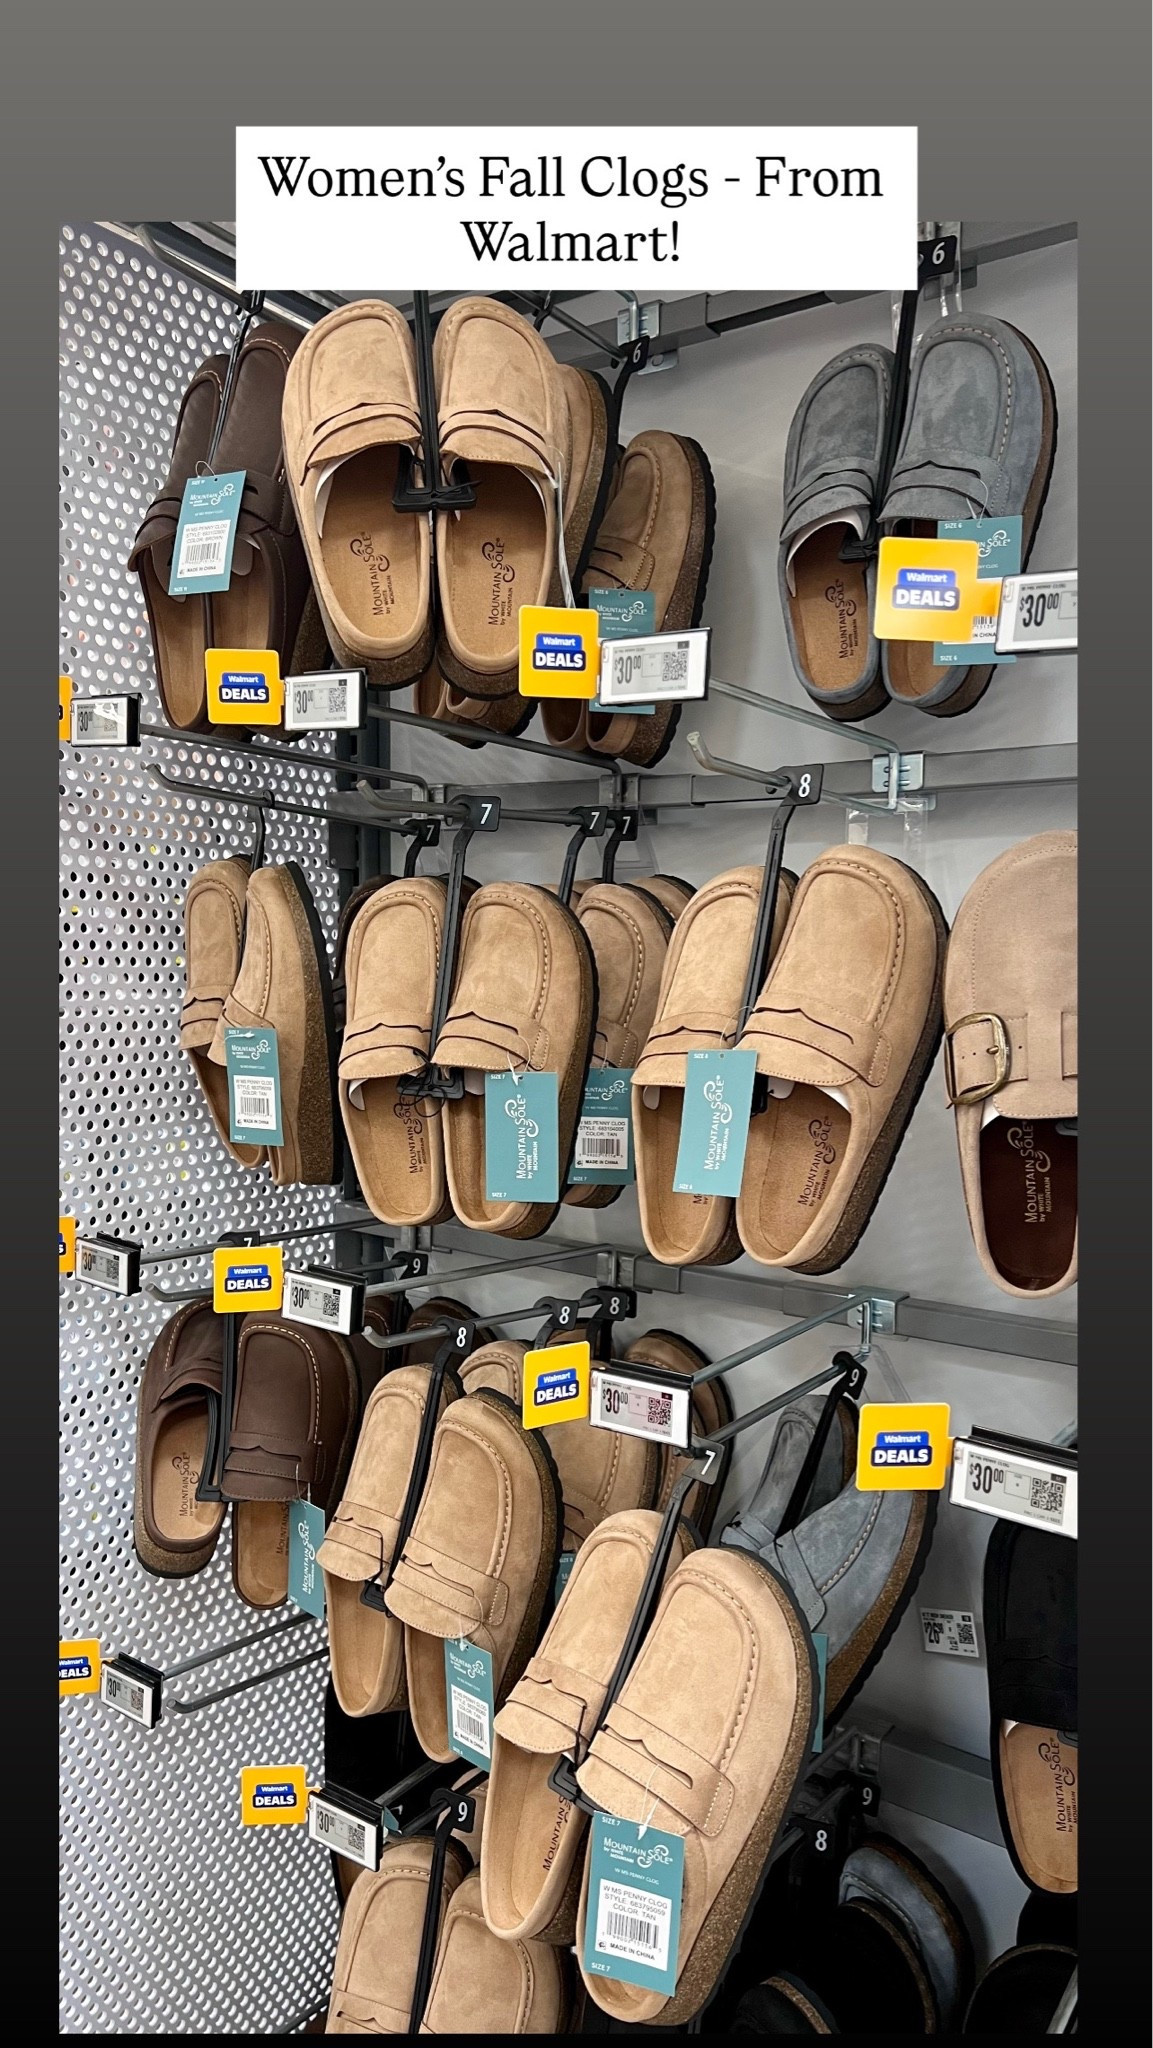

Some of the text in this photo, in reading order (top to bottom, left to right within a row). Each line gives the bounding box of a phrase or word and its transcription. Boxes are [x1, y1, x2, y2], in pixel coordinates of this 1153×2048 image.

[932, 241, 945, 265] 6
[632, 342, 642, 363] 6
[906, 571, 948, 584] Walmart
[369, 564, 384, 616] MOUNTAIN
[488, 571, 502, 626] MOUNTAIN
[895, 589, 957, 608] DEALS
[506, 587, 514, 617] MOUNTAIN
[596, 604, 628, 614] MOUNTAIN
[543, 636, 576, 646] Walmart
[838, 608, 849, 659] MOUNTAIN
[535, 652, 584, 669] DEALS
[228, 675, 260, 684] Walmart
[221, 688, 267, 701] DEALS
[798, 773, 812, 798] 8
[480, 803, 492, 825] 7
[589, 811, 600, 830] 7
[426, 824, 435, 842] 7
[622, 816, 632, 835] 7
[231, 1044, 257, 1053] MOUNTAIN
[703, 1078, 725, 1170] MOUNTAIN SOLE
[407, 1126, 419, 1174] MOUNTAIN
[515, 1128, 527, 1180] MOUNTAIN
[720, 1127, 730, 1162] MOUNTAIN
[714, 1143, 723, 1170] by WHITE
[797, 1119, 833, 1206] MOUNTAIN SOLE
[527, 1171, 533, 1179] by
[1020, 1122, 1038, 1223] MOUNTAIN SOLE
[817, 1169, 831, 1201] MOUNTAIN
[1044, 1176, 1052, 1213] MOUNTAIN
[233, 1267, 263, 1275] Walmart
[412, 1258, 421, 1274] 9
[227, 1277, 270, 1291] DEALS
[559, 1305, 570, 1325] 8
[609, 1296, 620, 1315] 8
[456, 1326, 467, 1348] 8
[543, 1372, 571, 1384] Walmart
[848, 1368, 860, 1387] 9
[536, 1384, 577, 1404] DEALS
[884, 1434, 922, 1444] Walmart
[701, 1450, 716, 1476] 7
[874, 1450, 929, 1464] DEALS
[178, 1474, 190, 1517] MOUNTAIN
[302, 1549, 311, 1593] MOUNTAIN
[260, 1785, 289, 1793] Walmart
[862, 1787, 873, 1806] 9
[255, 1795, 295, 1807] DEALS
[1055, 1773, 1067, 1832] MOUNTAIN
[458, 1801, 468, 1822] 9
[602, 1816, 615, 1826] SIZE
[542, 1806, 566, 1871] MOUNTAIN
[603, 1837, 648, 1858] MOUNTAIN
[815, 1829, 828, 1852] 8
[609, 1852, 635, 1864] MOUNTAIN
[628, 1871, 645, 1880] PENNY
[646, 1876, 660, 1885] CLOG
[611, 1887, 622, 1895] MS
[623, 1890, 647, 1902] PENNY
[648, 1897, 668, 1909] CLOG
[642, 1911, 657, 1921] TAN
[609, 1942, 627, 1953] MADE
[636, 1949, 656, 1961] CHINA
[591, 1961, 606, 1972] SIZE
